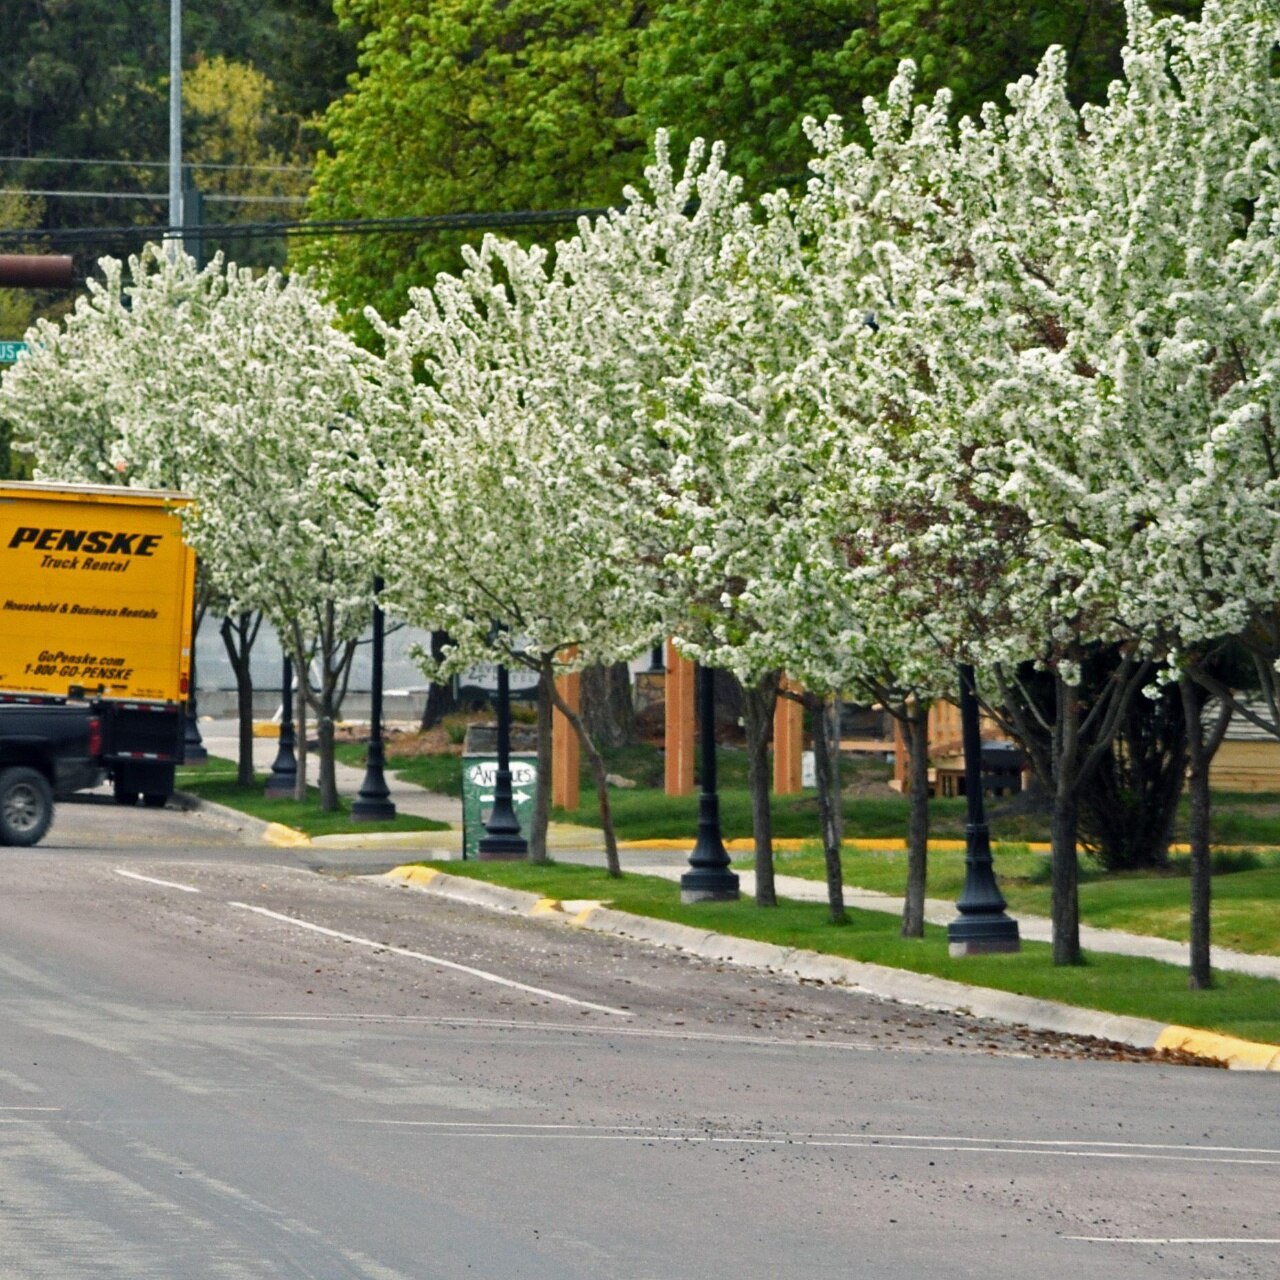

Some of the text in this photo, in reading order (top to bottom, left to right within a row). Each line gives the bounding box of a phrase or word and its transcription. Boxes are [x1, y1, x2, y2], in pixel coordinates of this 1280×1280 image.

[8, 527, 163, 556] PENSKE
[41, 555, 130, 572] Truck Rental
[3, 600, 158, 619] Household & Business Rentals
[38, 650, 125, 666] GoPenske.com
[25, 663, 134, 680] 1-800-GO-PENSKE
[473, 765, 532, 784] ANUES
